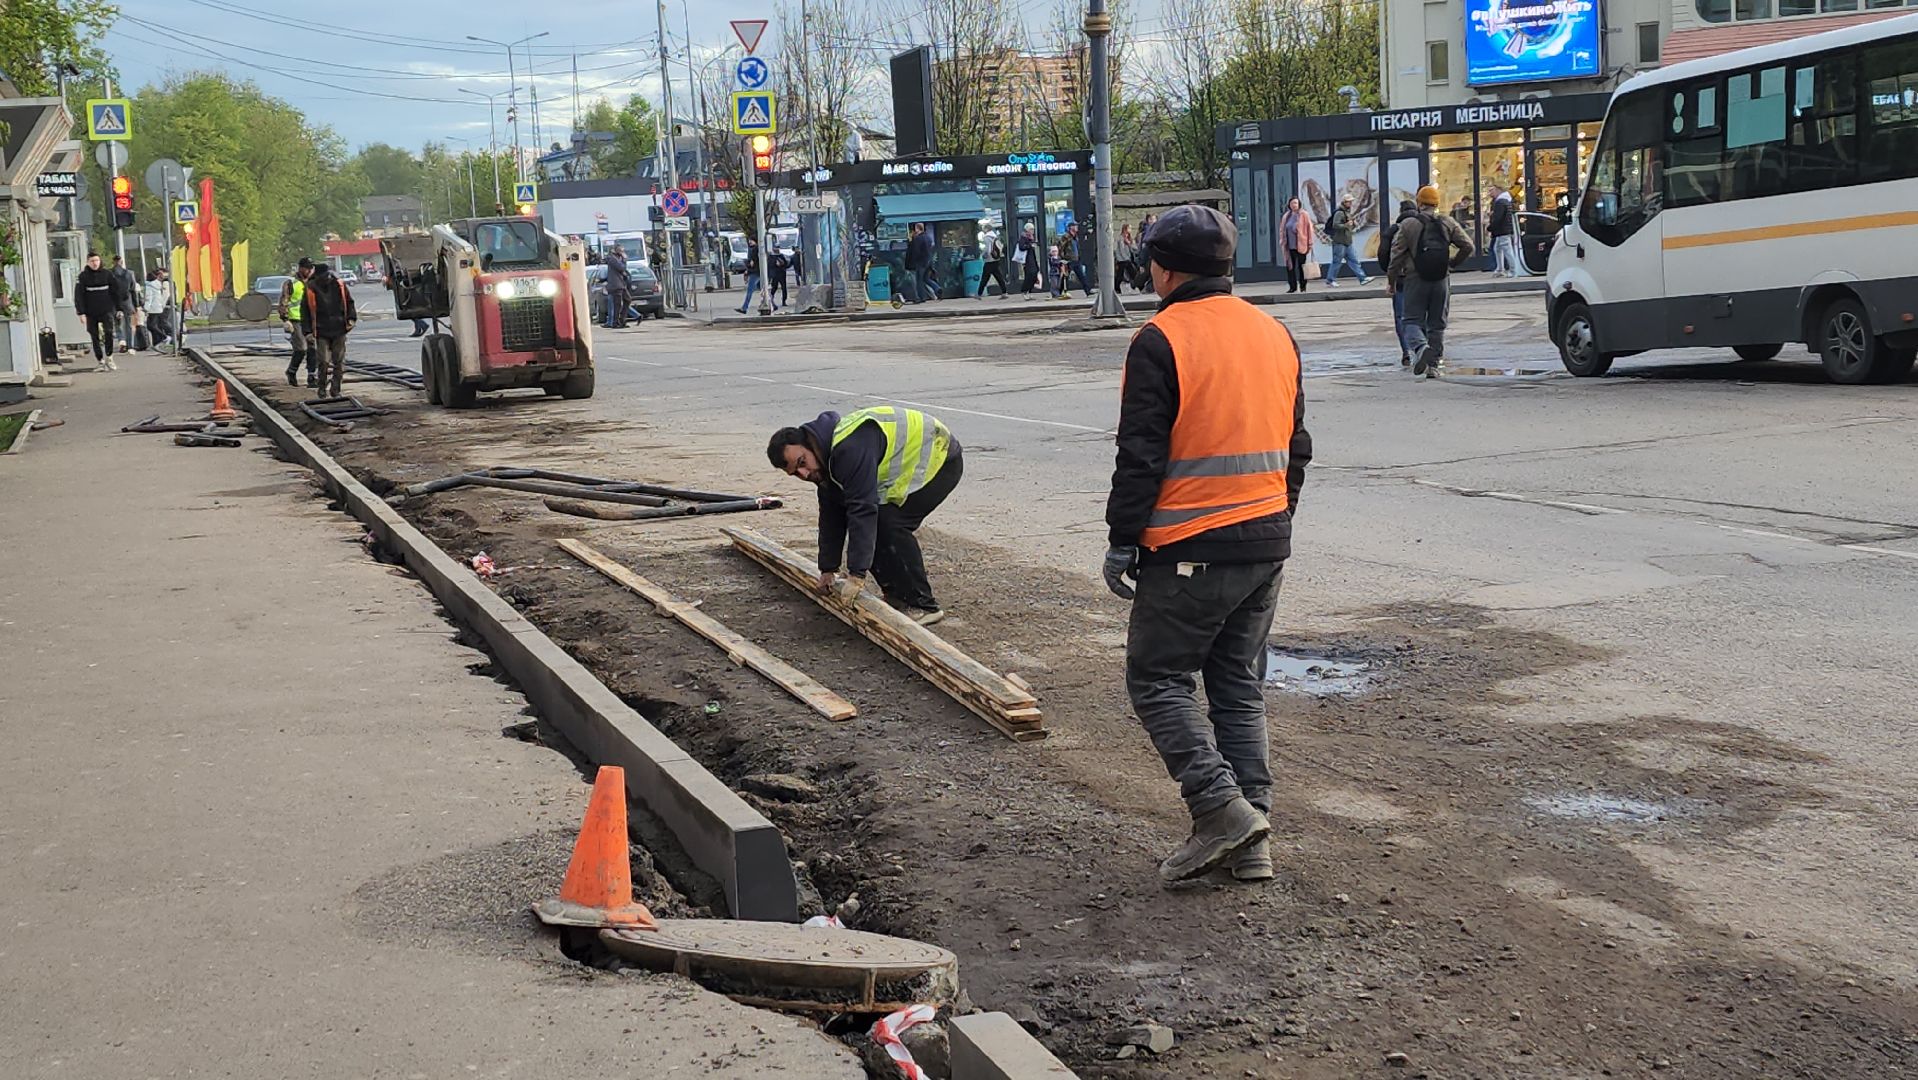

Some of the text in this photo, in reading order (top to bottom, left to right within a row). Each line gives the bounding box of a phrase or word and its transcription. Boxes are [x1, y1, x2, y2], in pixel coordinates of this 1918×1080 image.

[1370, 102, 1544, 131] ПЕКАРНЯ МЕЛЬНИЦА
[986, 161, 1077, 174] РЕМОНТ ТЕЛЕФОНОВ
[40, 174, 75, 183] ТАБАК
[797, 199, 823, 210] СТО
